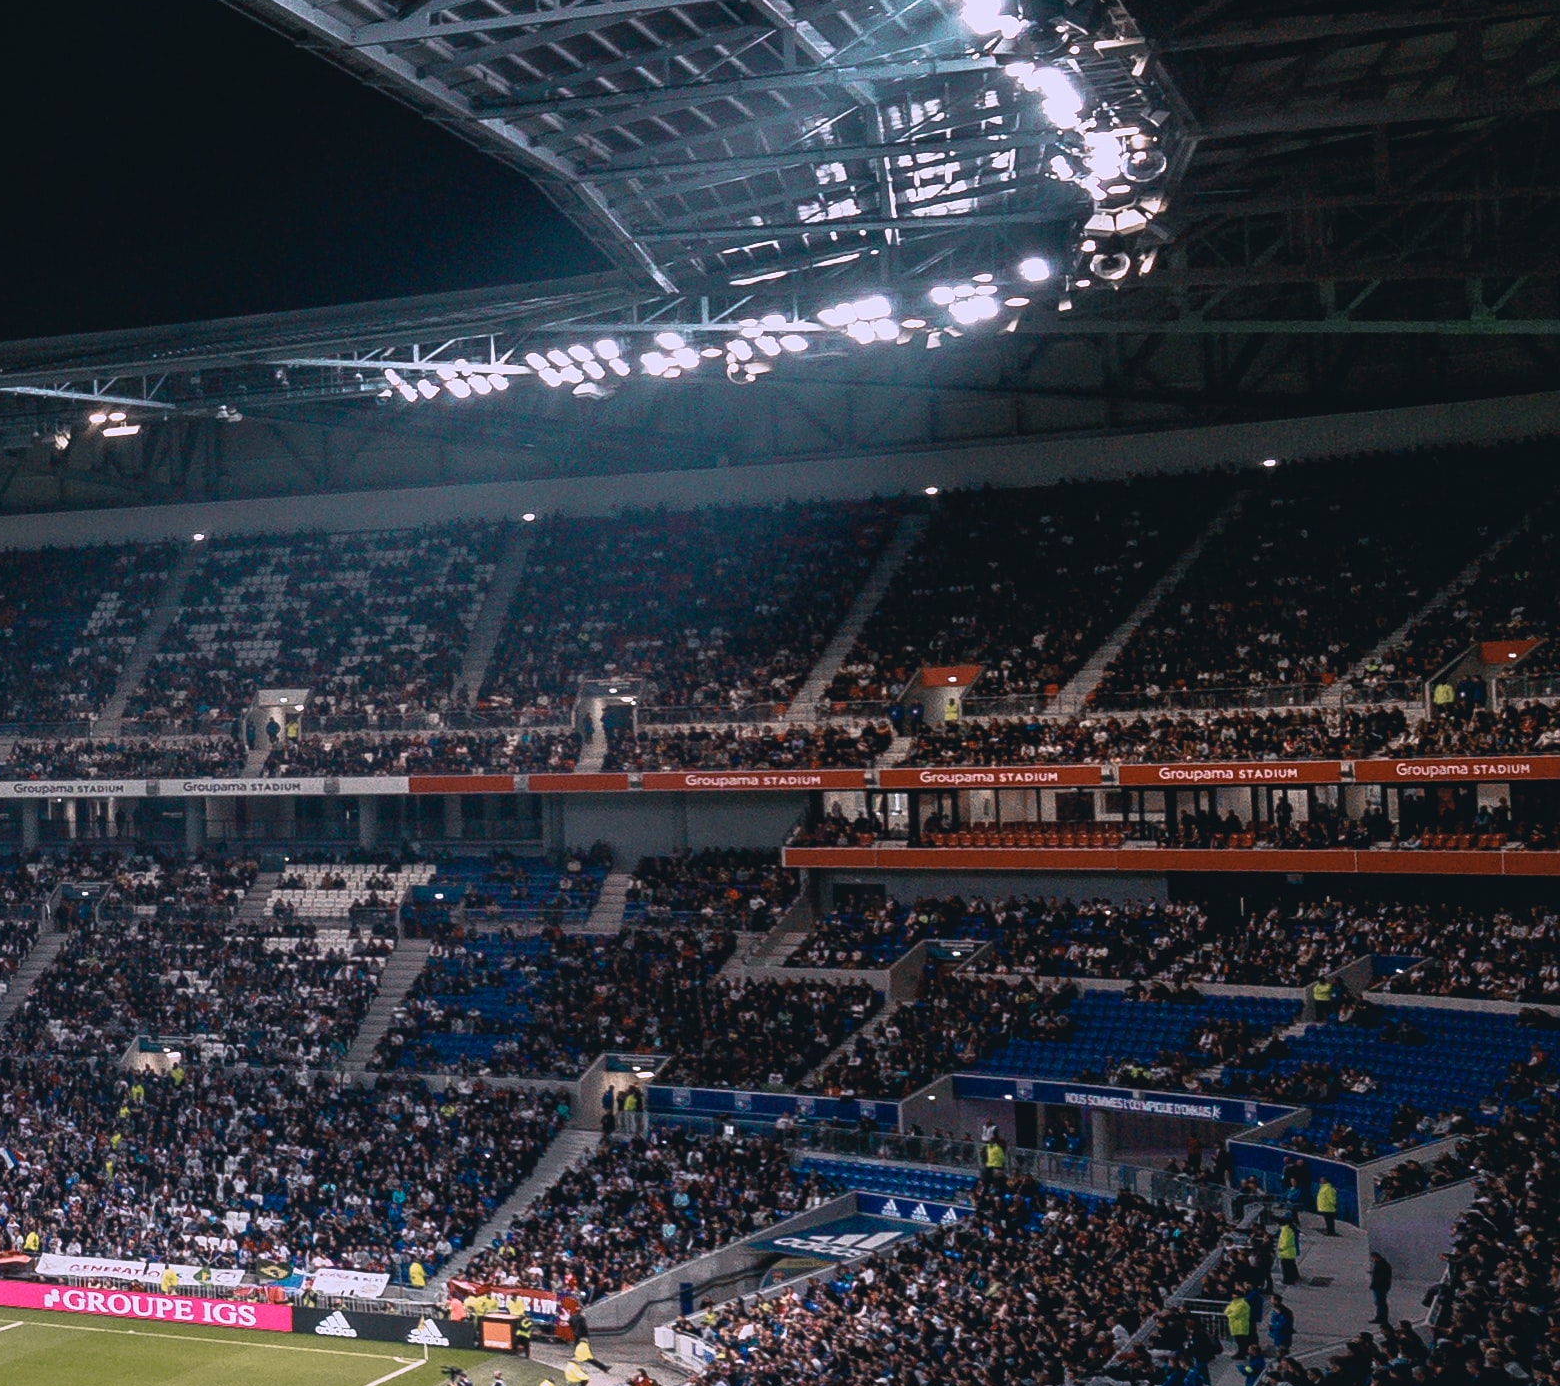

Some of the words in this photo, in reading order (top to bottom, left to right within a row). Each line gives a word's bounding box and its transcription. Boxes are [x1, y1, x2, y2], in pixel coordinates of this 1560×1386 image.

[1159, 767, 1234, 780] Groupama
[1239, 768, 1298, 778] STADIUM
[1396, 763, 1468, 777] Groupama
[1472, 764, 1530, 774] STADIUM
[686, 774, 758, 787] Groupama
[763, 776, 821, 785] STADIUM
[920, 772, 994, 784] Groupama
[999, 773, 1058, 783] STADIUM
[14, 783, 73, 794] Groupama
[77, 785, 124, 794] STADIUM
[183, 781, 246, 793] Groupama
[250, 783, 300, 792] STADIUM
[71, 1289, 194, 1322] GROUPE
[202, 1302, 257, 1326] IGS
